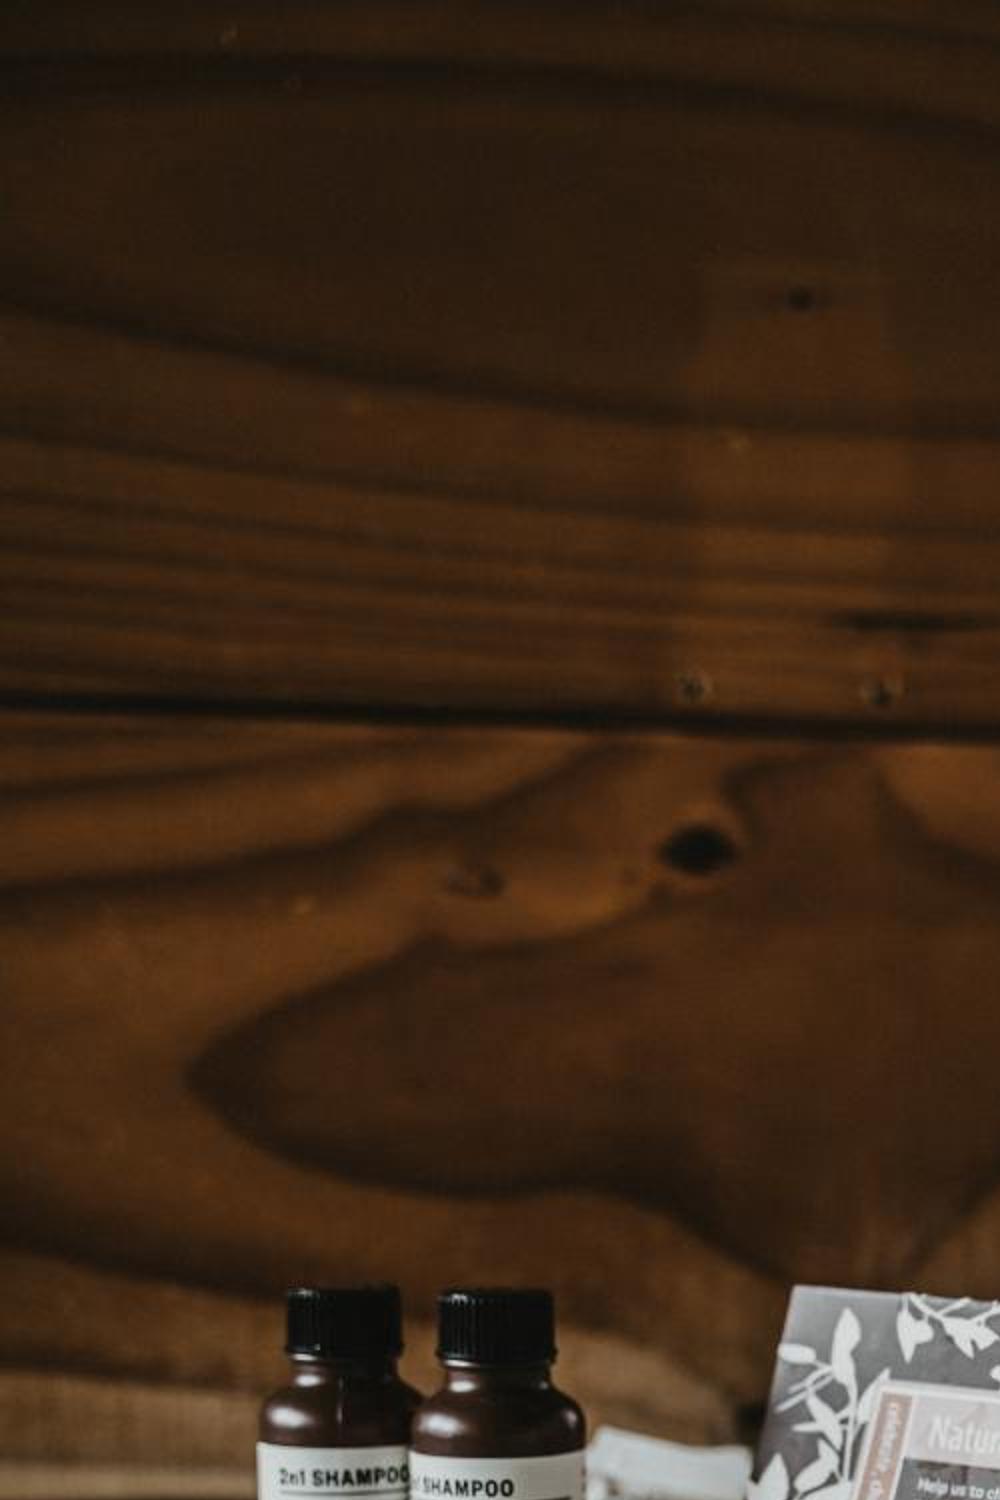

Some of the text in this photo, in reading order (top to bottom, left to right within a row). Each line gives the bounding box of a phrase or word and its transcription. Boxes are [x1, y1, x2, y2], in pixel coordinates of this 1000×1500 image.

[279, 1468, 306, 1485] 2n1
[312, 1464, 410, 1487] SHAMPOO
[423, 1475, 514, 1498] SHAMPOO
[917, 1477, 948, 1495] Help
[951, 1485, 966, 1495] us
[969, 1485, 984, 1499] to
